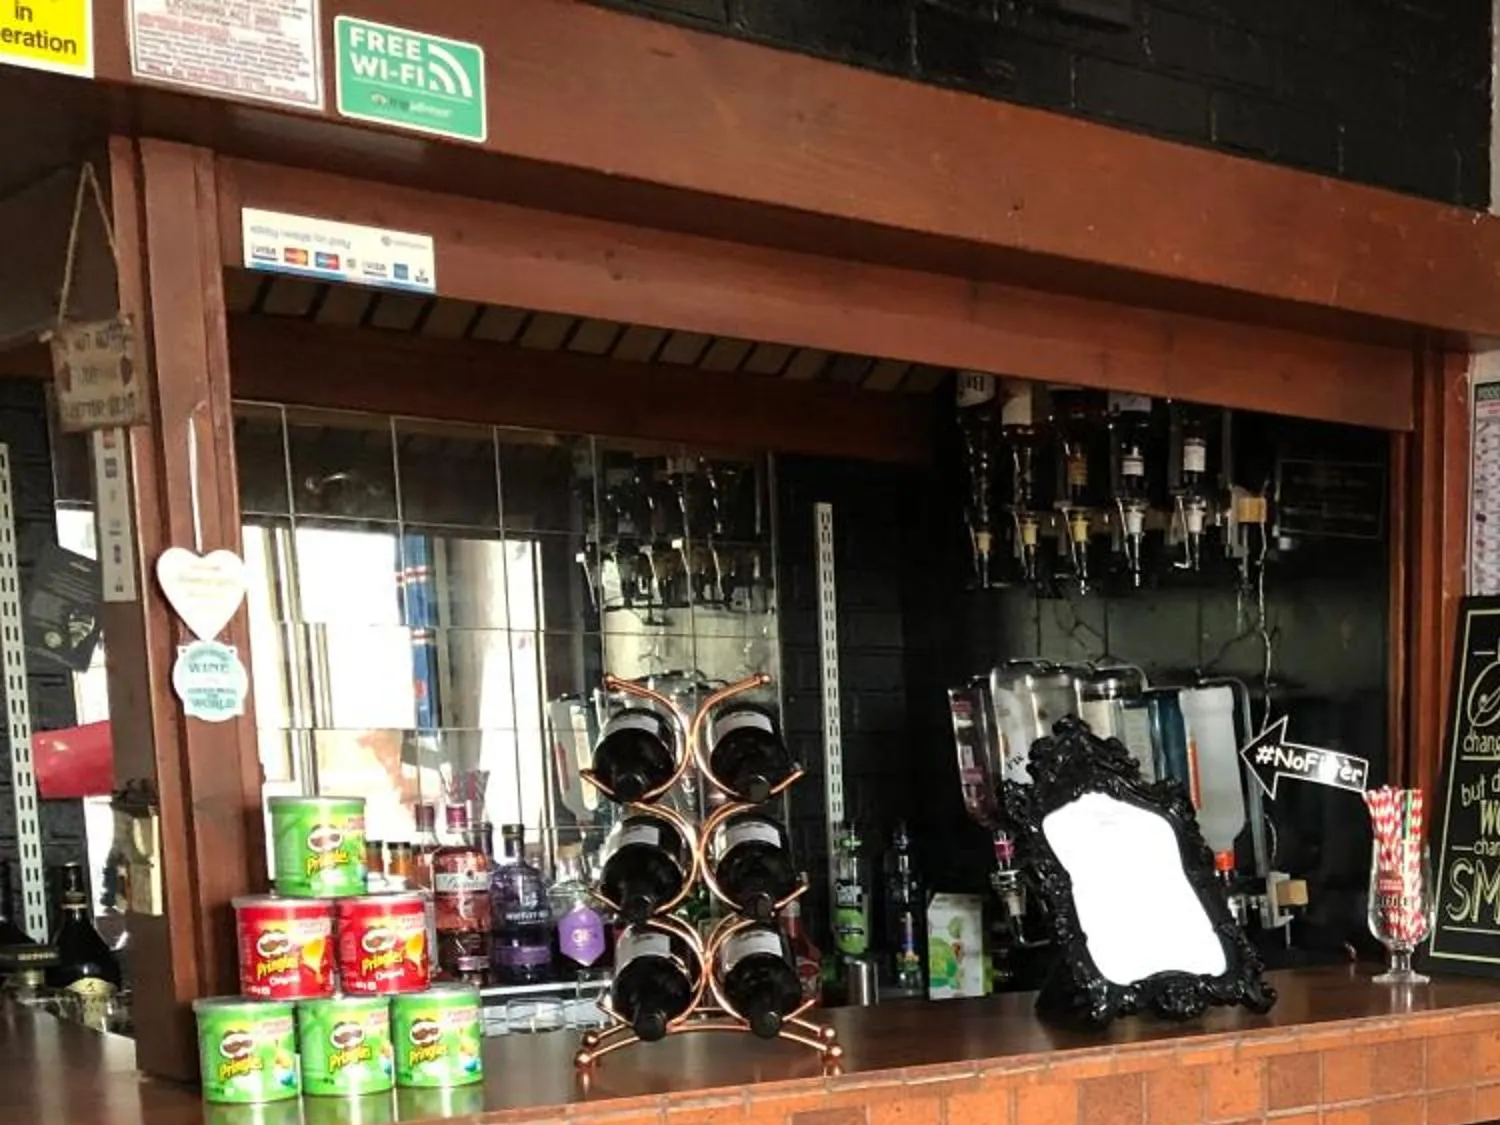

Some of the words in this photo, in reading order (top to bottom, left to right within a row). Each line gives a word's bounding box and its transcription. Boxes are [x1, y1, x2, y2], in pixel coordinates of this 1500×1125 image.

[15, 0, 33, 23] in
[0, 27, 77, 56] eration
[349, 26, 422, 61] FREE
[349, 51, 425, 88] WI-FI
[1255, 745, 1363, 783] #NoFer
[1460, 773, 1487, 807] but
